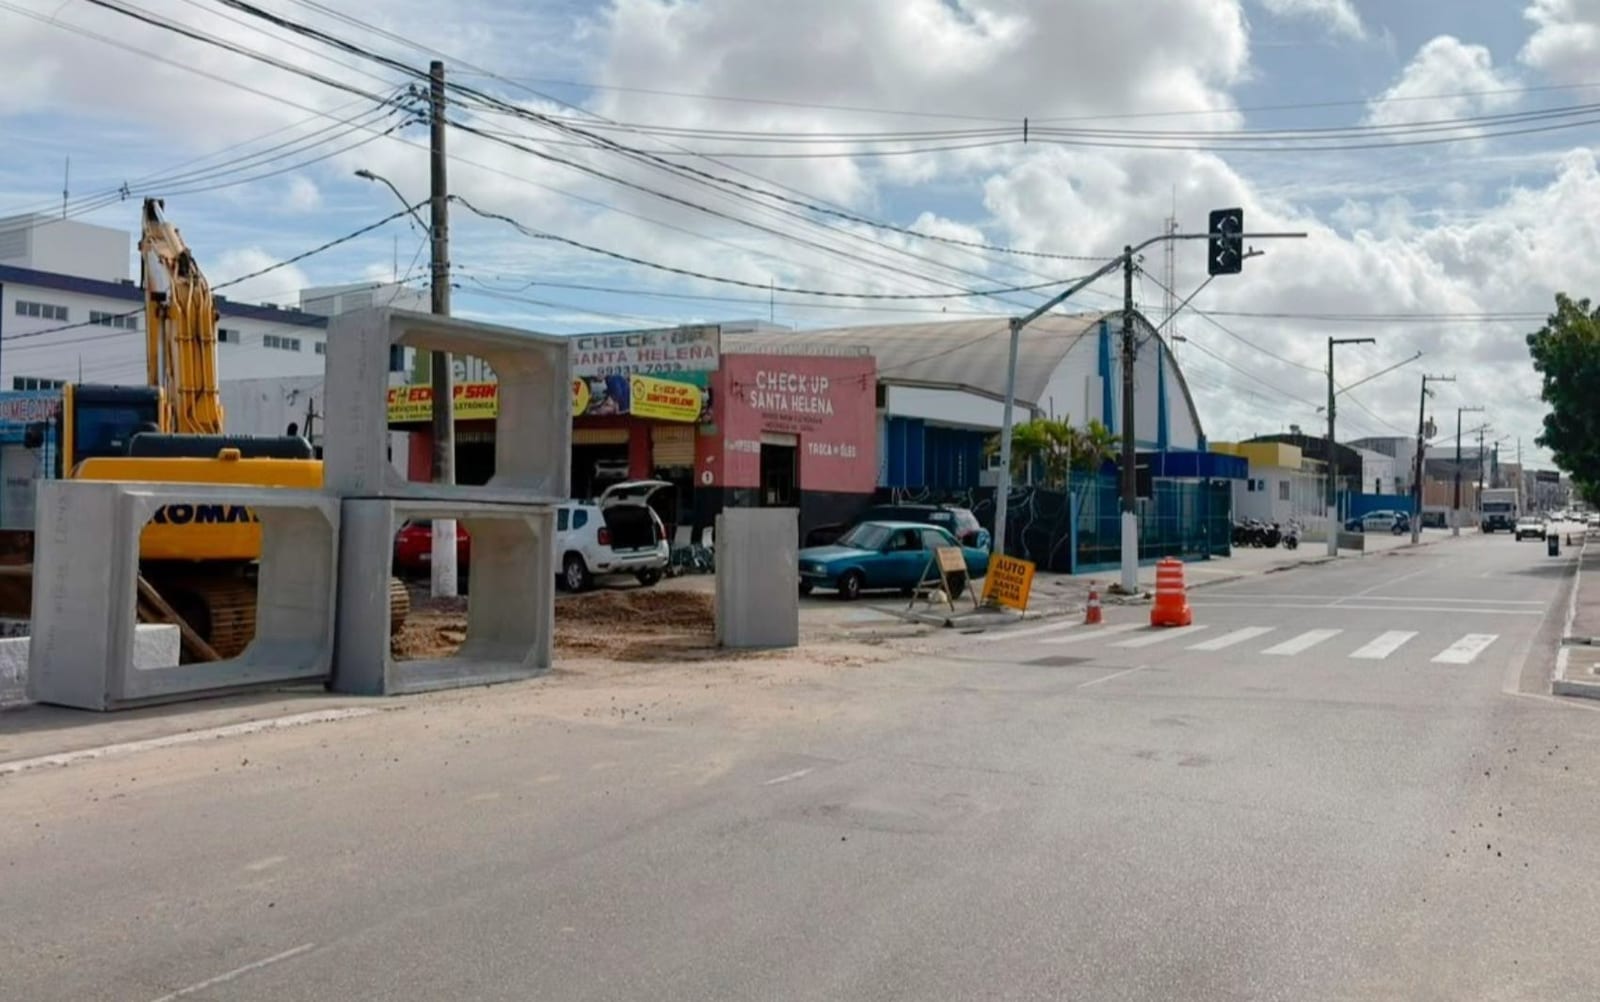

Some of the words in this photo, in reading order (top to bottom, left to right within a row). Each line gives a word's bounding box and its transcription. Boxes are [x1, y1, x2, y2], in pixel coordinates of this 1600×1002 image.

[750, 390, 788, 411] SANTA
[791, 396, 834, 415] HELENA
[147, 503, 260, 524] KOMA
[996, 559, 1026, 576] AUTO
